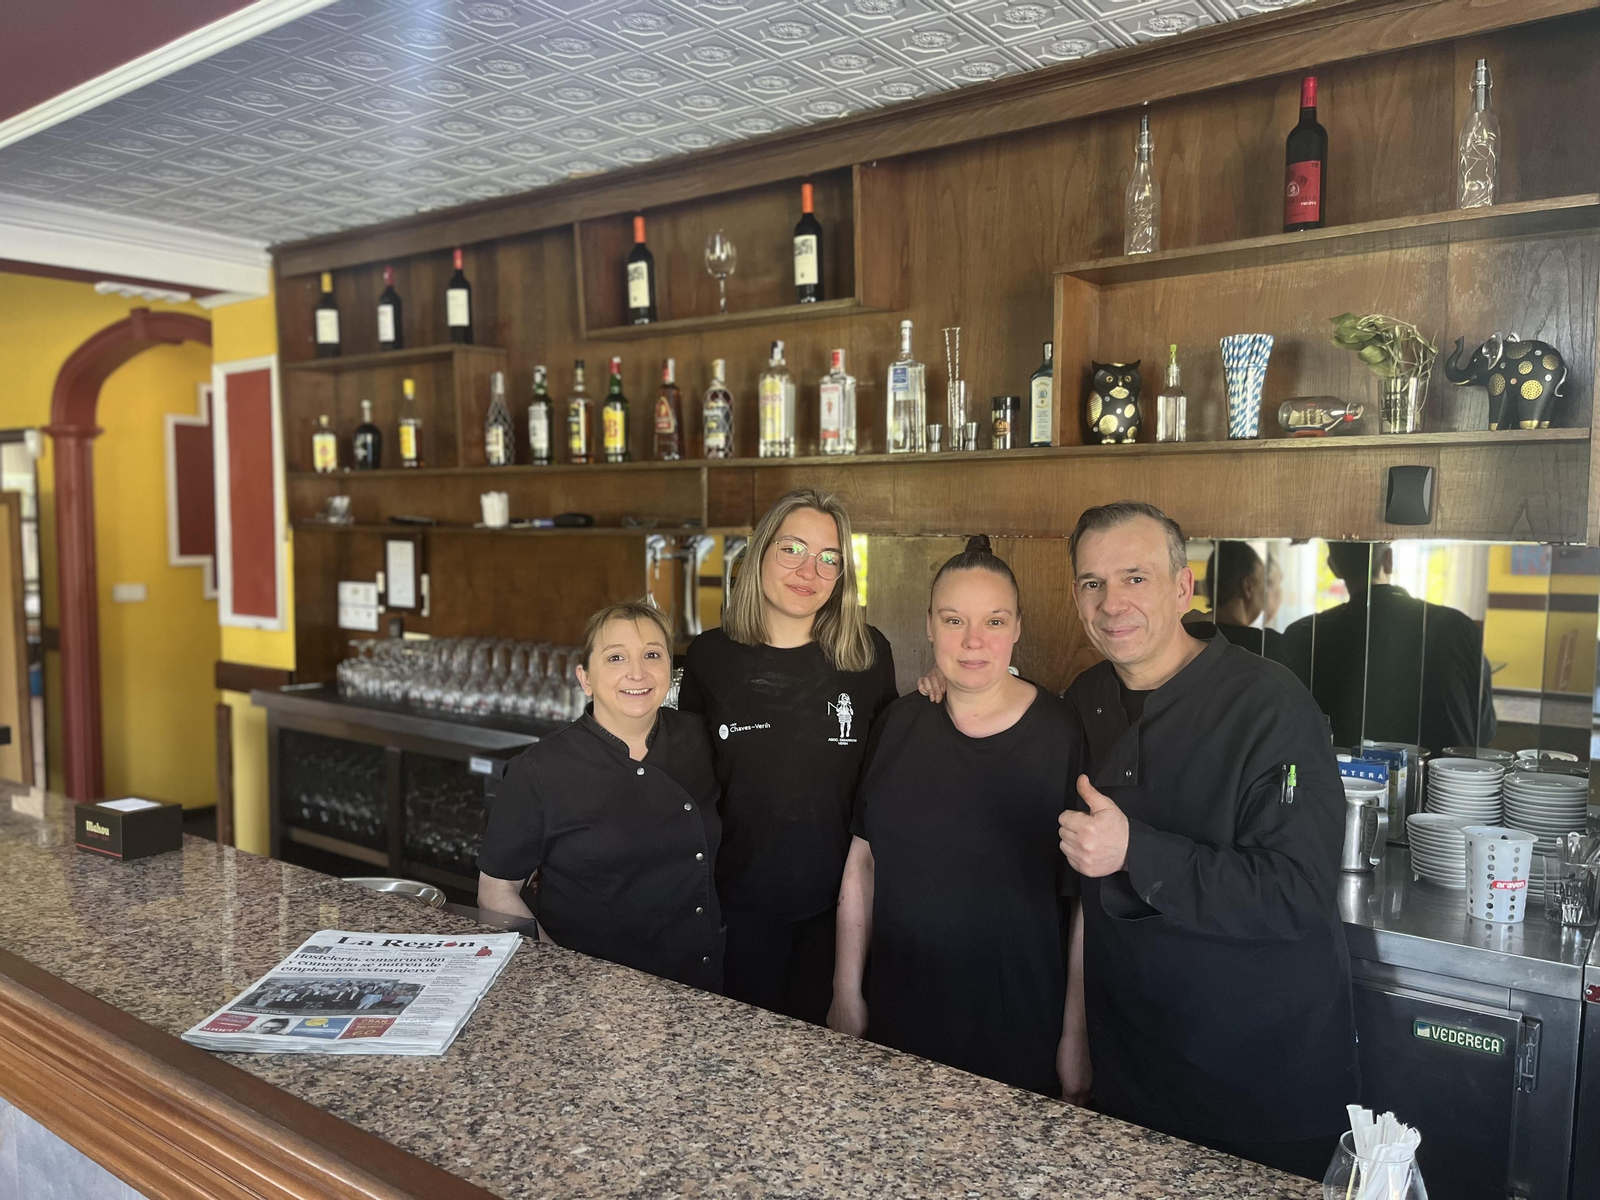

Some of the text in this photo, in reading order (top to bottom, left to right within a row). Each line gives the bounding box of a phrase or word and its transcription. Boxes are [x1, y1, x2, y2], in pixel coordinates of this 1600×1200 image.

[1341, 769, 1384, 780] NTERA
[86, 820, 110, 836] Mahou
[1496, 881, 1525, 889] araven
[338, 936, 374, 946] La
[295, 953, 361, 962] Hostelería,
[1431, 1025, 1500, 1053] VEDERECA
